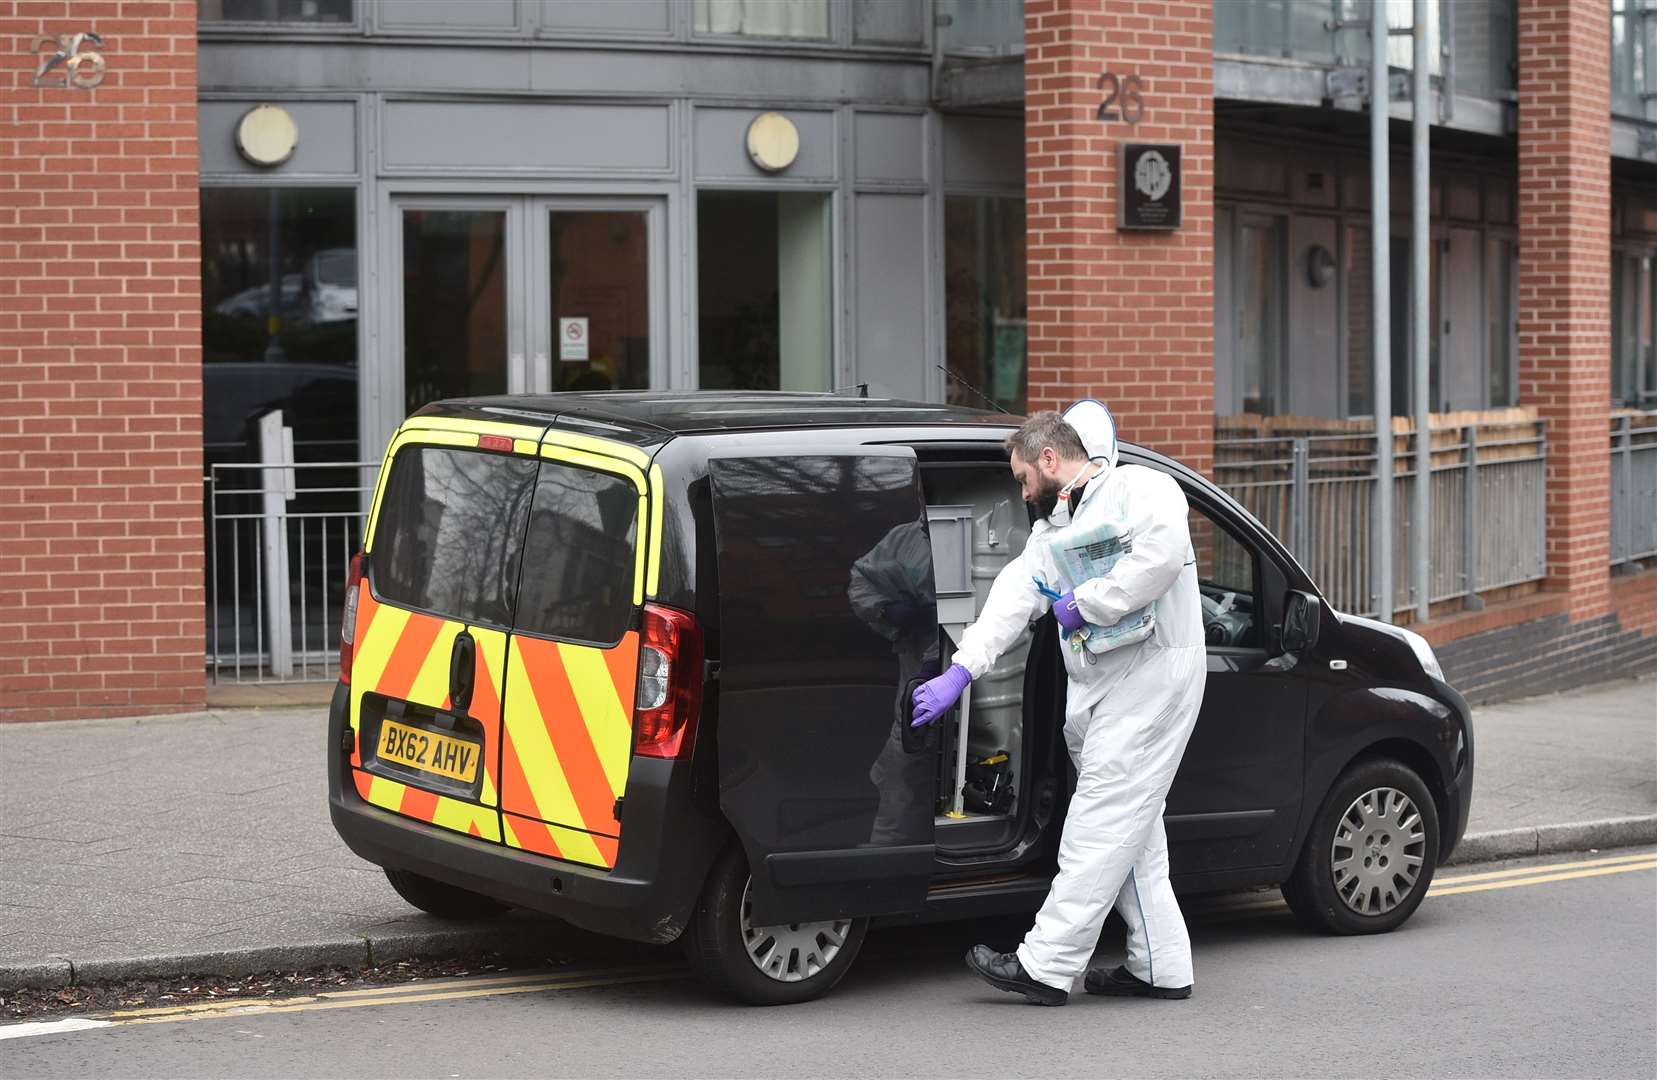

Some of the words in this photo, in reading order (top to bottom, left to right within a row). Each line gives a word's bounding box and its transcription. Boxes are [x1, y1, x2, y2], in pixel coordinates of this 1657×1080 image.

[31, 32, 105, 89] 26
[1097, 72, 1144, 124] 26
[385, 727, 429, 764] BX62
[431, 740, 472, 775] AHV
